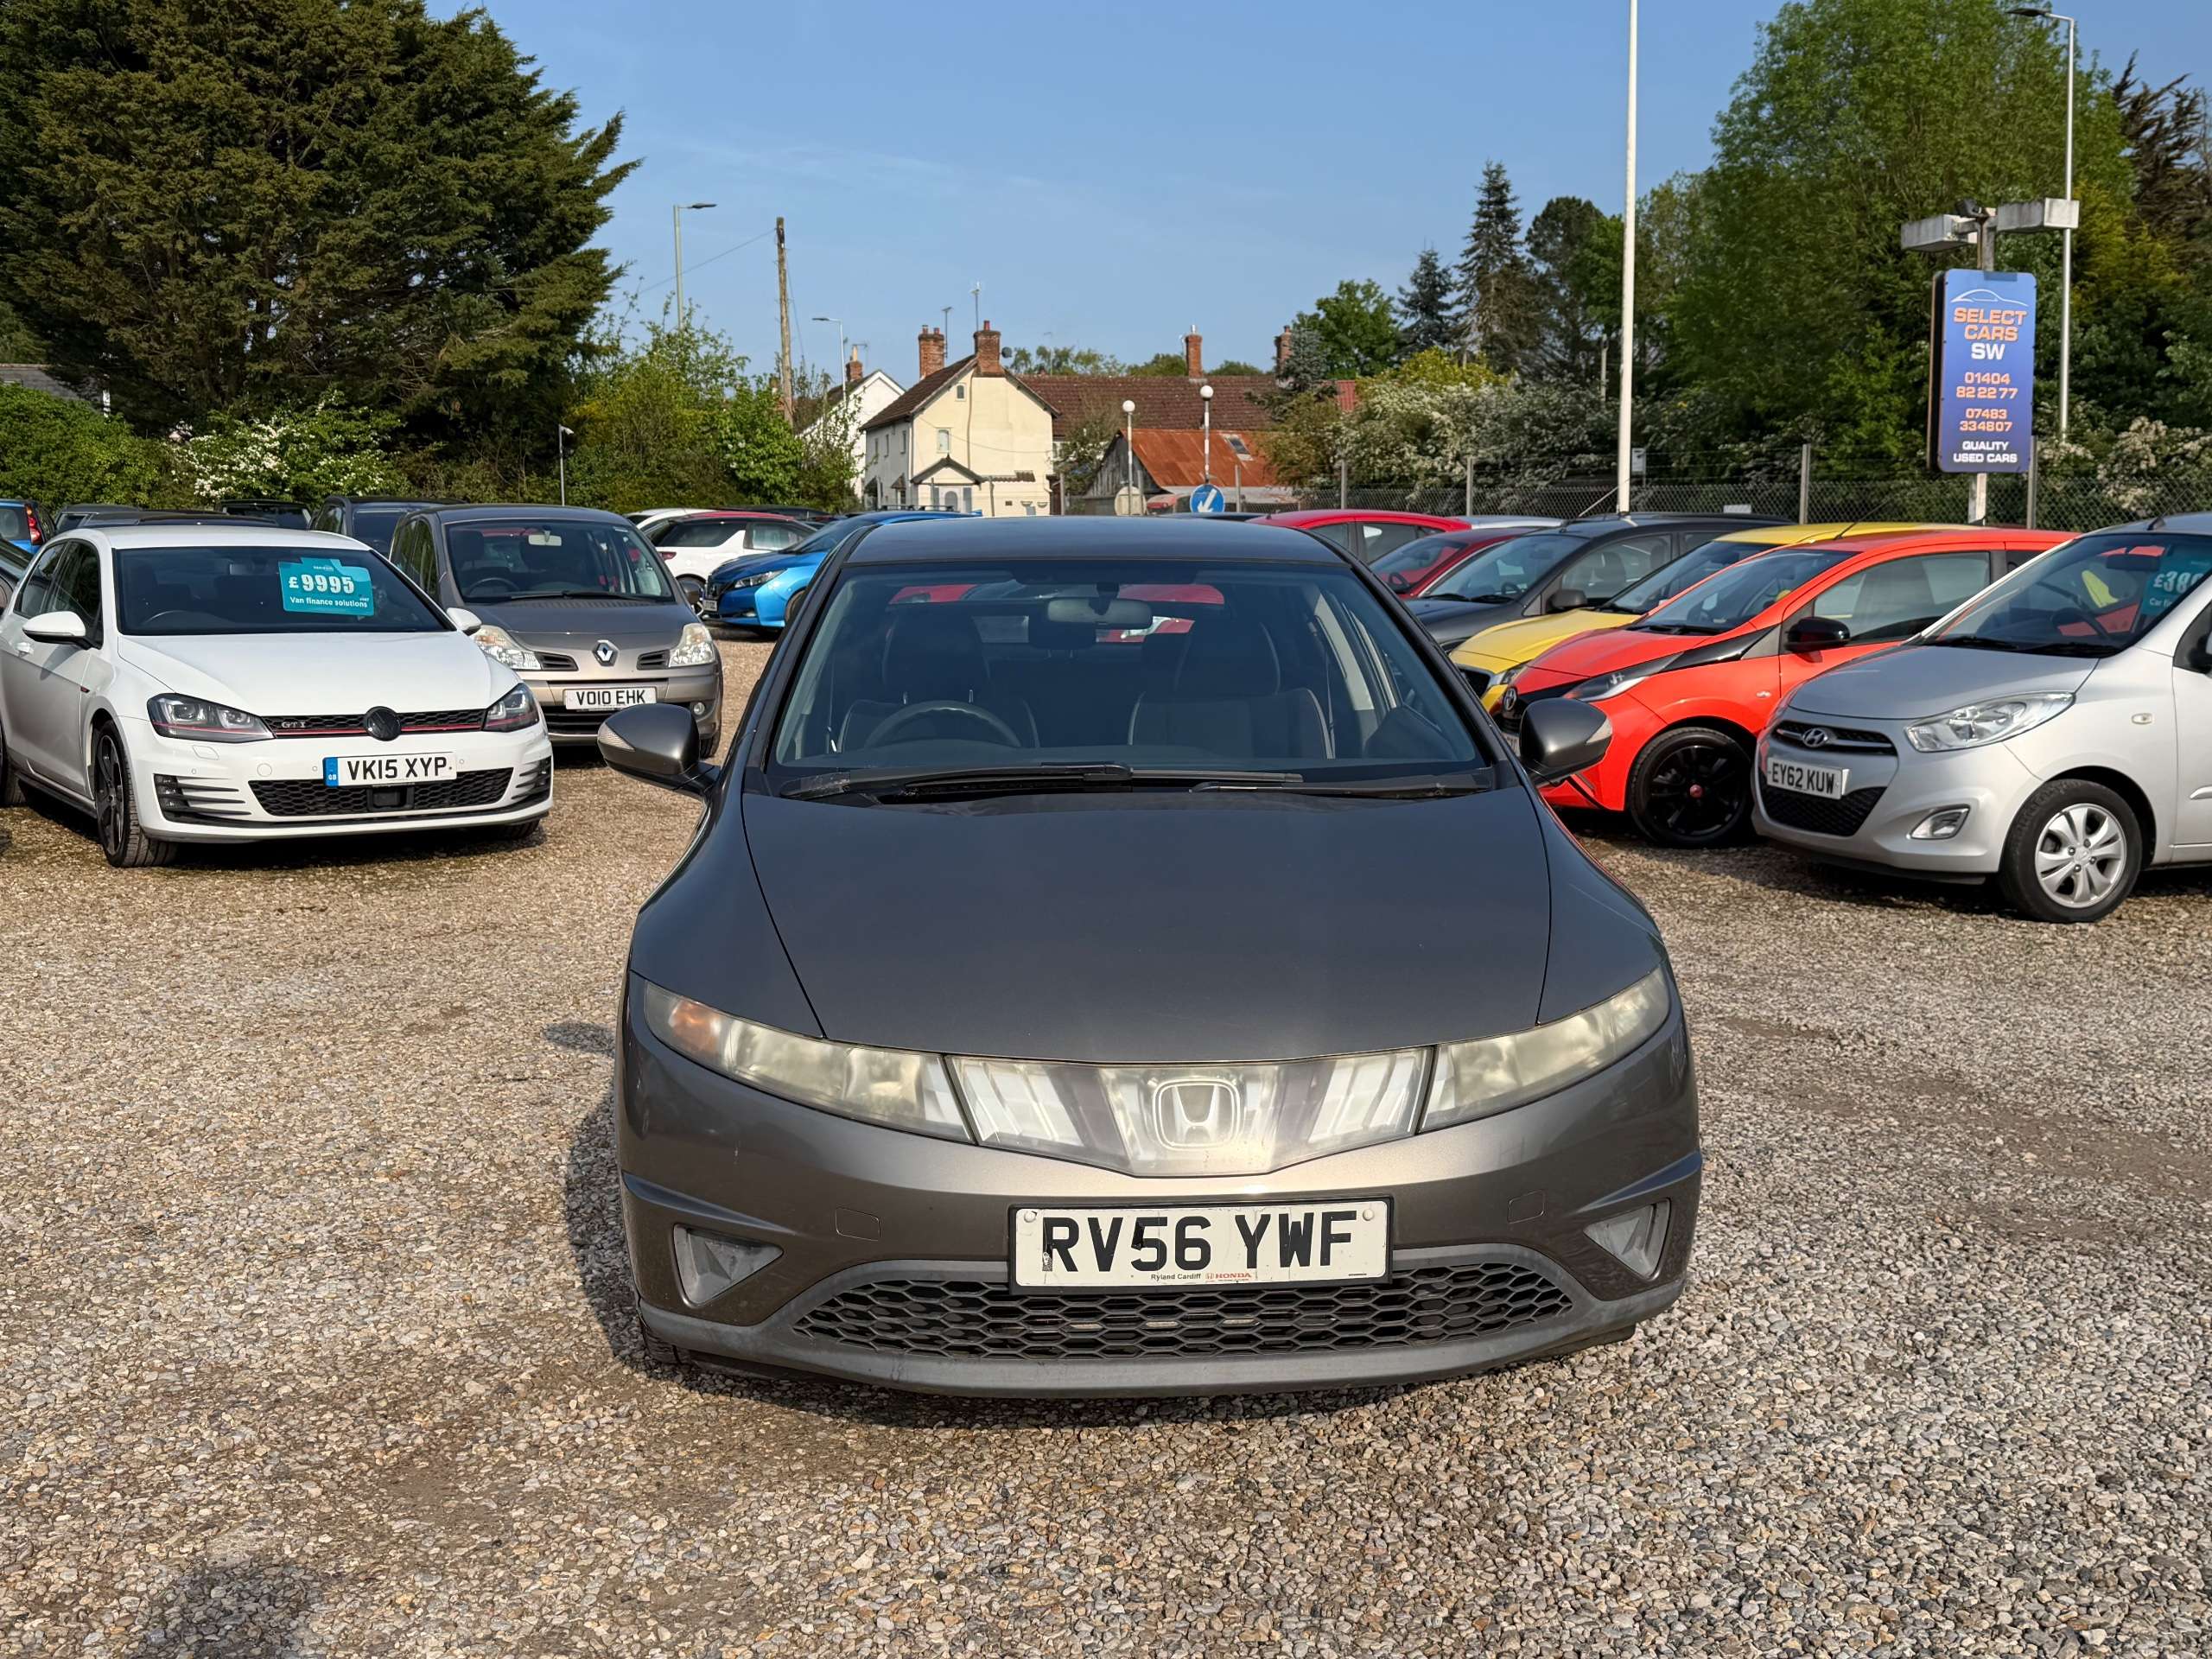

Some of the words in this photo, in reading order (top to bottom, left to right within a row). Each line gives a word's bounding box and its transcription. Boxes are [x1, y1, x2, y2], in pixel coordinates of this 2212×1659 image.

[1954, 308, 2027, 326] SELECT
[1964, 324, 2018, 341] CARS
[1971, 342, 2005, 360] SW
[1964, 372, 2011, 385] 01404
[1965, 408, 2007, 420] 07483
[1961, 441, 2009, 451] QUALITY
[1953, 453, 1985, 463] USED
[1986, 453, 2018, 463] CARS
[306, 597, 334, 606] finance
[334, 598, 368, 608] solutions
[575, 690, 611, 705] VO10
[616, 690, 645, 704] EHK
[347, 759, 398, 781] VK15
[404, 756, 447, 778] XYP
[1772, 763, 1803, 788] EY62
[1807, 769, 1834, 794] KUW
[1042, 1215, 1211, 1273] RV56
[1235, 1210, 1357, 1269] YWF
[1150, 1274, 1176, 1282] Ryland
